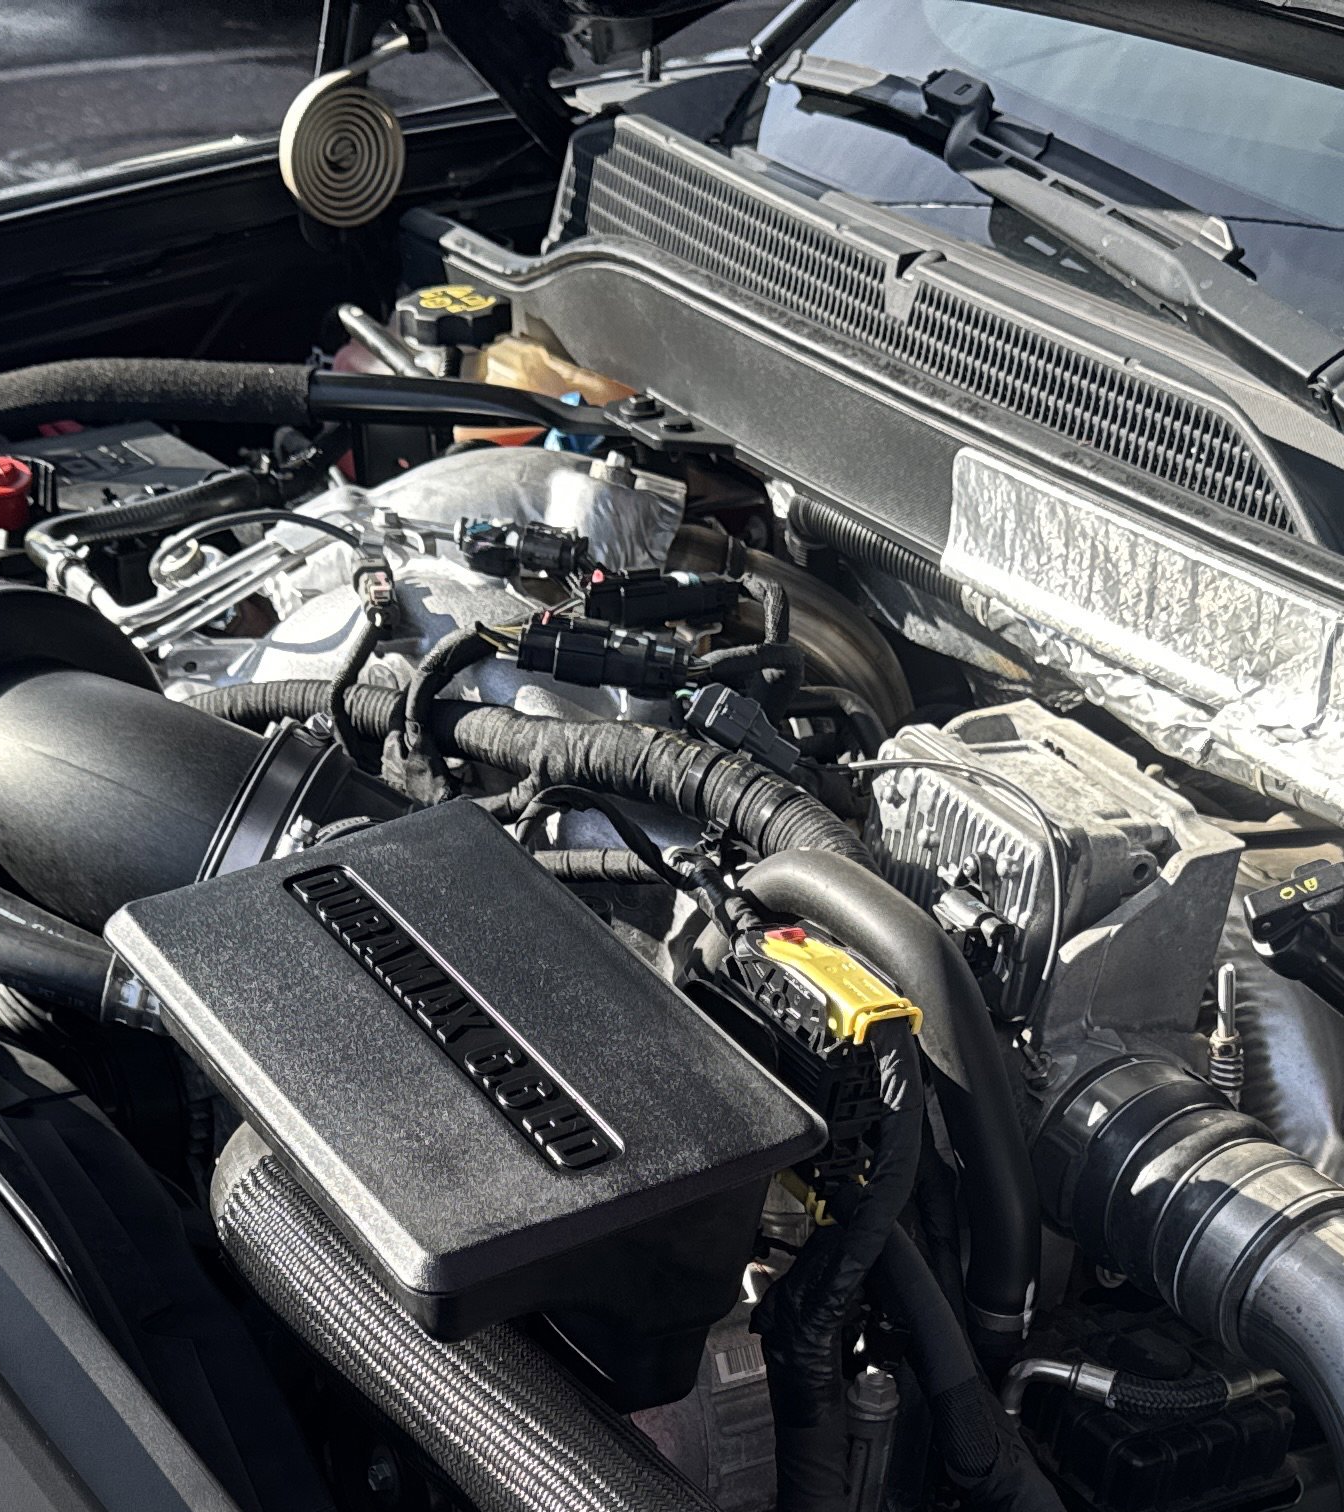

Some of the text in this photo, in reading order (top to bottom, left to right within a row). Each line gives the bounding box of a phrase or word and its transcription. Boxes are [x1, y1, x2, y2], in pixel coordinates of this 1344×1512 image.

[293, 872, 610, 1166] DURAMAX 6.6 HD
